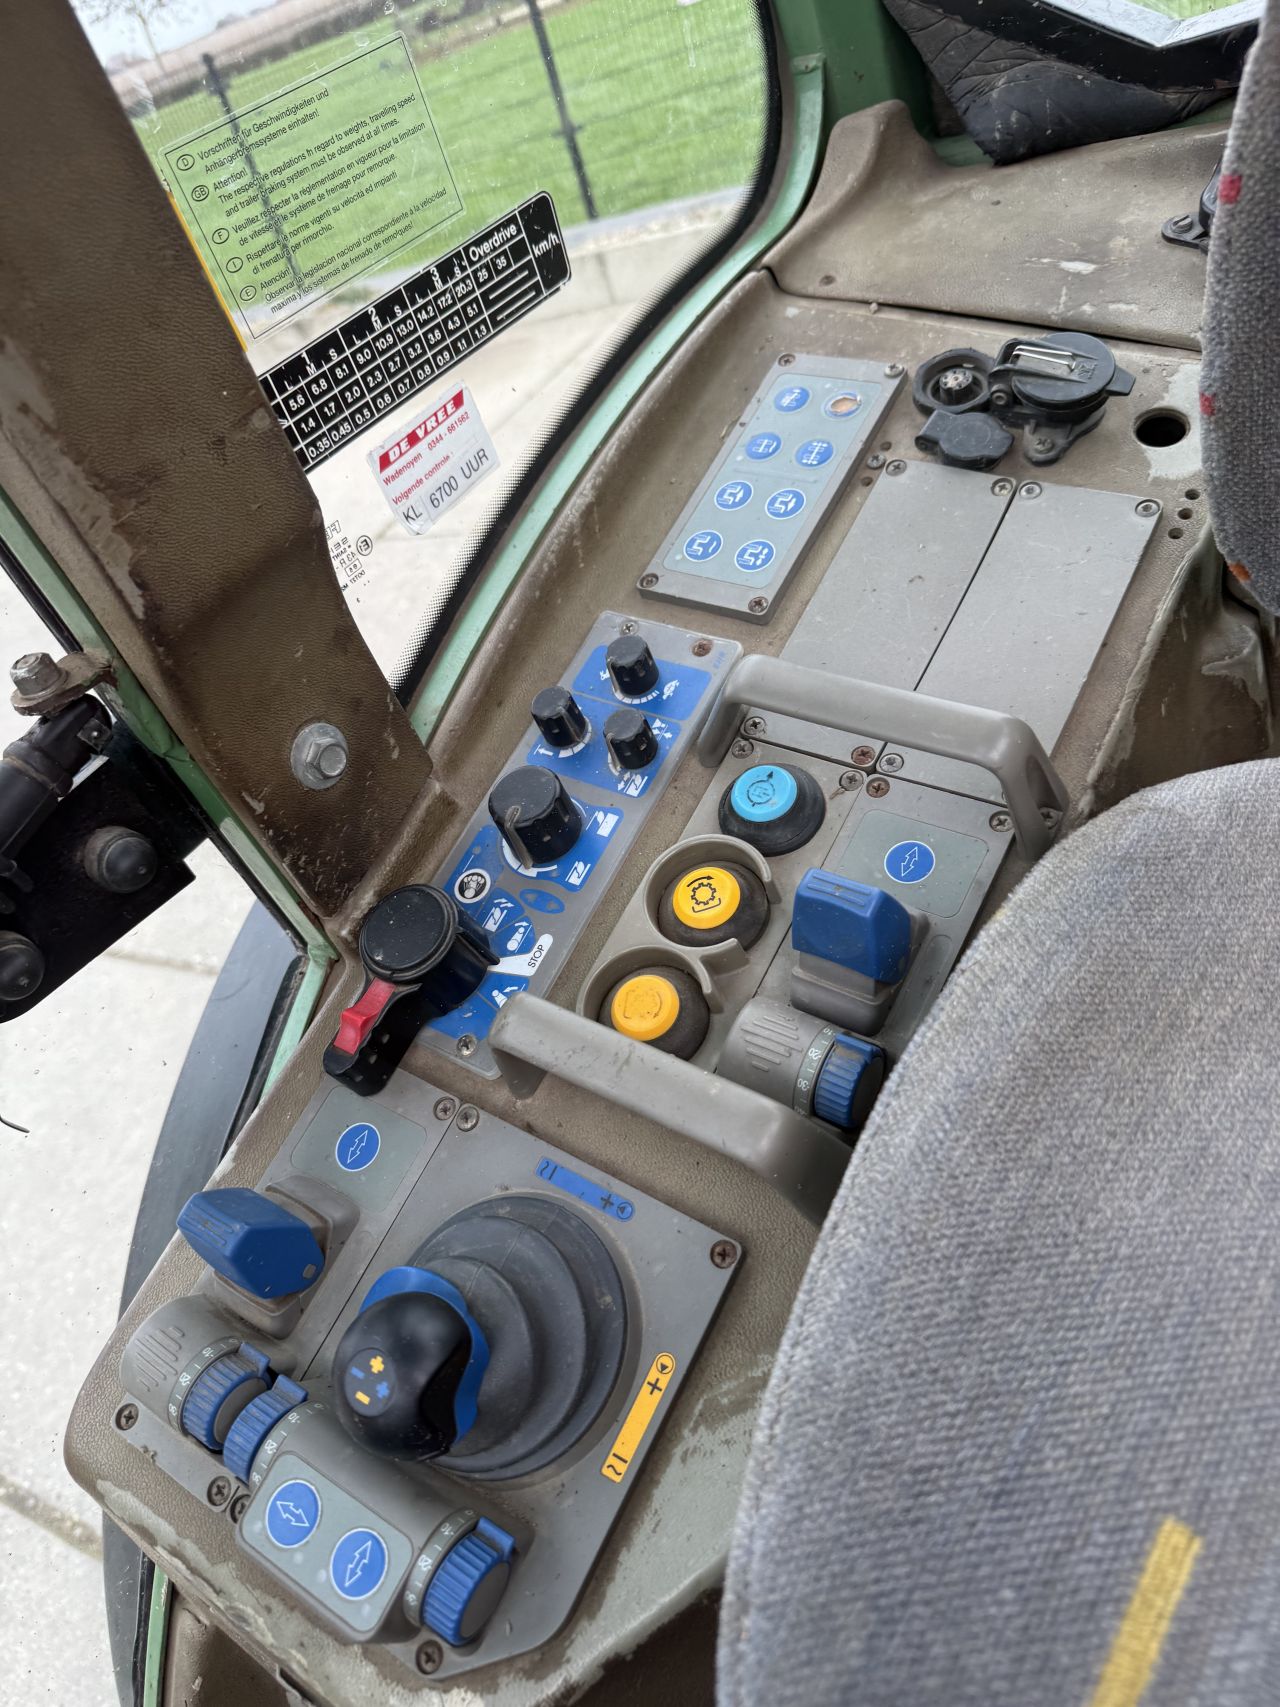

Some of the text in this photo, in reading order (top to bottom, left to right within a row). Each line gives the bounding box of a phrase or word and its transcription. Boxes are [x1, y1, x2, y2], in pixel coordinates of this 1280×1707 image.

[197, 87, 329, 160] Vorschriften für Geschwindigkeiten und
[217, 192, 233, 203] The
[233, 173, 270, 196] respective
[269, 152, 307, 177] regulations
[313, 135, 336, 153] regard
[335, 133, 343, 142] to
[368, 104, 397, 123] travelling
[396, 92, 416, 109] speed
[181, 157, 189, 167] D
[194, 187, 207, 199] GB
[212, 167, 247, 191] Attention!
[224, 117, 399, 217] and trailer braking system must be observed at all times.
[231, 214, 261, 233] Veuillez
[260, 196, 292, 219] respecter
[290, 192, 299, 201] la
[346, 161, 355, 170] en
[354, 148, 378, 166] vigueur
[377, 140, 392, 154] pour
[398, 122, 425, 140] limitation
[238, 236, 248, 246] de
[248, 222, 274, 240] vitesse
[316, 192, 326, 202] de
[325, 178, 352, 197] freinage
[351, 169, 367, 184] pour
[245, 238, 282, 263] Rispettare
[288, 222, 309, 238] norme
[310, 209, 332, 226] vigenti
[331, 204, 340, 213] su
[364, 183, 374, 194] ed
[373, 170, 397, 189] impianti
[264, 279, 296, 302] Observar
[335, 238, 362, 259] nacional
[362, 211, 409, 244] correspondiente
[419, 186, 447, 208] velocidad
[532, 232, 560, 258] km/h
[251, 266, 260, 275] di
[259, 248, 291, 270] frenatura
[290, 241, 302, 254] per
[301, 284, 313, 294] los
[312, 267, 341, 288] sistemas
[340, 261, 349, 270] de
[349, 247, 373, 264] frenado
[373, 241, 382, 251] de
[367, 306, 379, 322] 2
[429, 266, 439, 282] 3
[468, 224, 517, 261] Overdrive
[284, 265, 462, 391] L M S L M S L M S
[288, 256, 507, 411] 5.6 6.8 8.1 9.0 10.9 13.0 14.2 17.2 20.3 25 35
[300, 302, 478, 433] 1.4 1.7 2.0 2.3 2.7 3.2 3.6 4.3 5.1
[308, 324, 487, 458] 0.35 0.45 0.5 0.6 0.7 0.8 0.9 1.1 1.3
[382, 452, 422, 486] Wadenoyen
[427, 433, 443, 450] 0344
[388, 400, 456, 461] DE VREE
[392, 478, 423, 505] Volgende
[424, 455, 450, 480] controle
[402, 448, 488, 523] KL 6700 UUR
[528, 944, 544, 968] STOP
